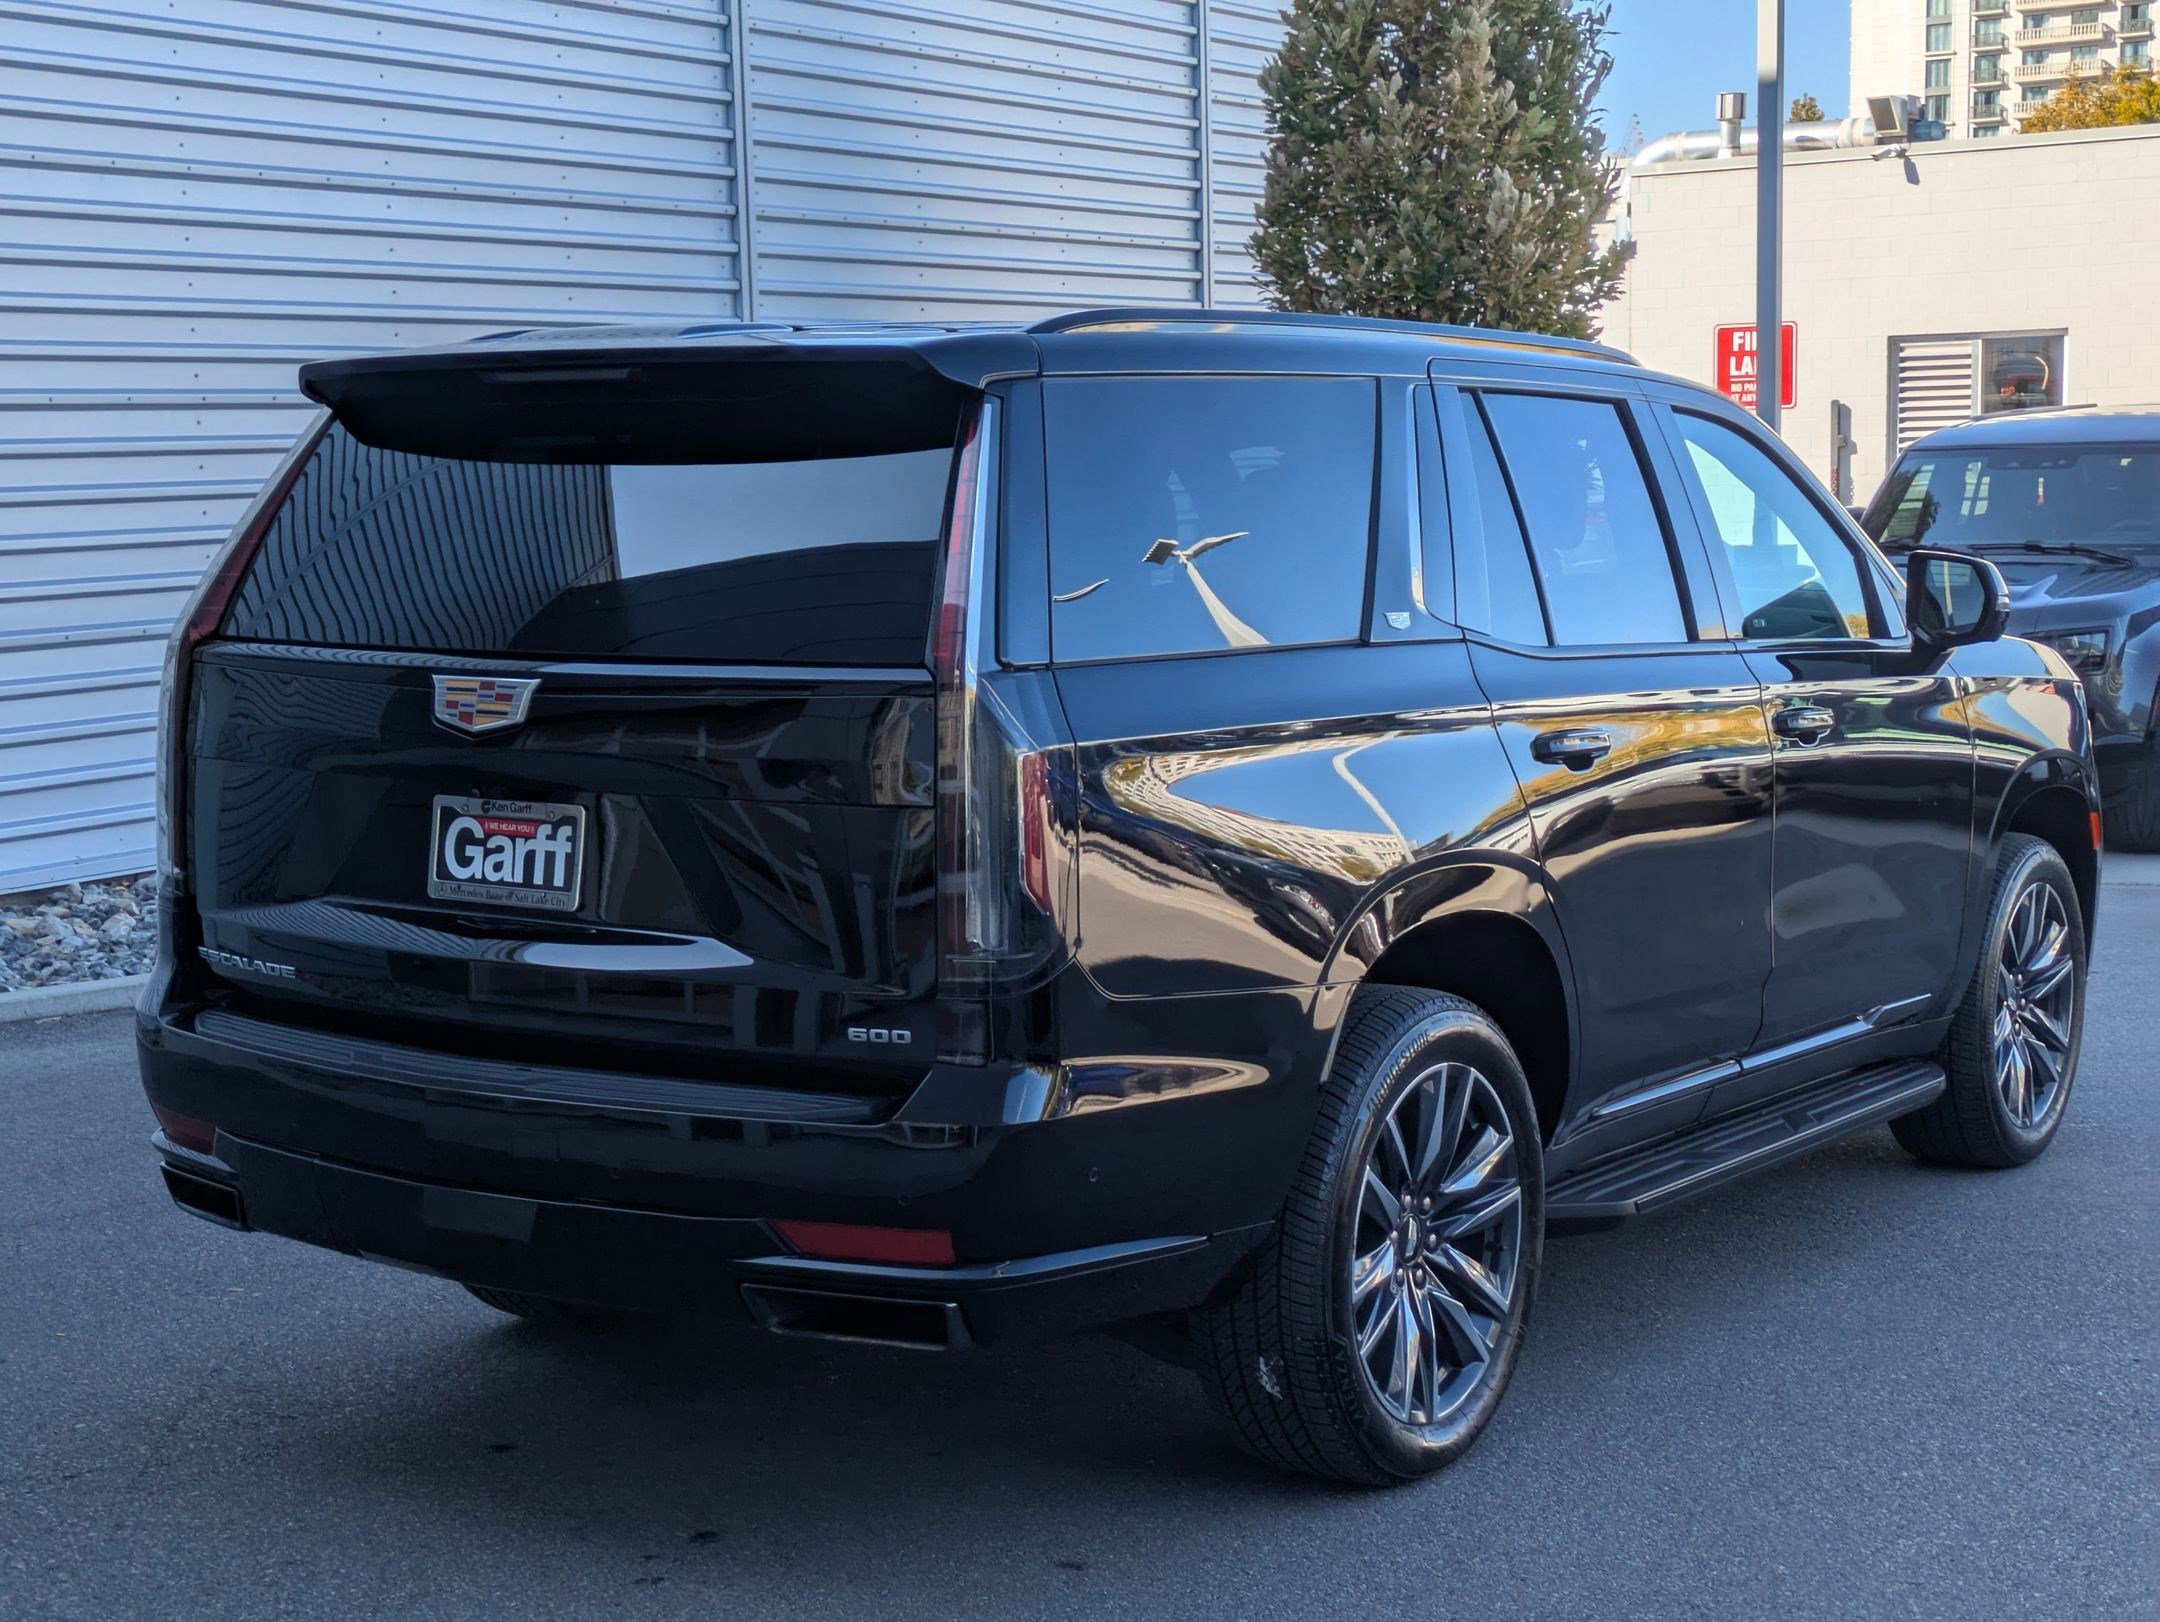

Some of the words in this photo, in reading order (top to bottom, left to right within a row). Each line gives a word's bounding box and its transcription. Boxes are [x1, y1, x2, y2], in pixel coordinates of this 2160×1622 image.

[1730, 383, 1743, 392] NO
[491, 800, 509, 812] Ken
[510, 802, 532, 814] Garff
[517, 825, 530, 833] YOU
[444, 816, 572, 887] Garff
[197, 946, 296, 978] ESCALADE
[847, 1027, 911, 1044] 600
